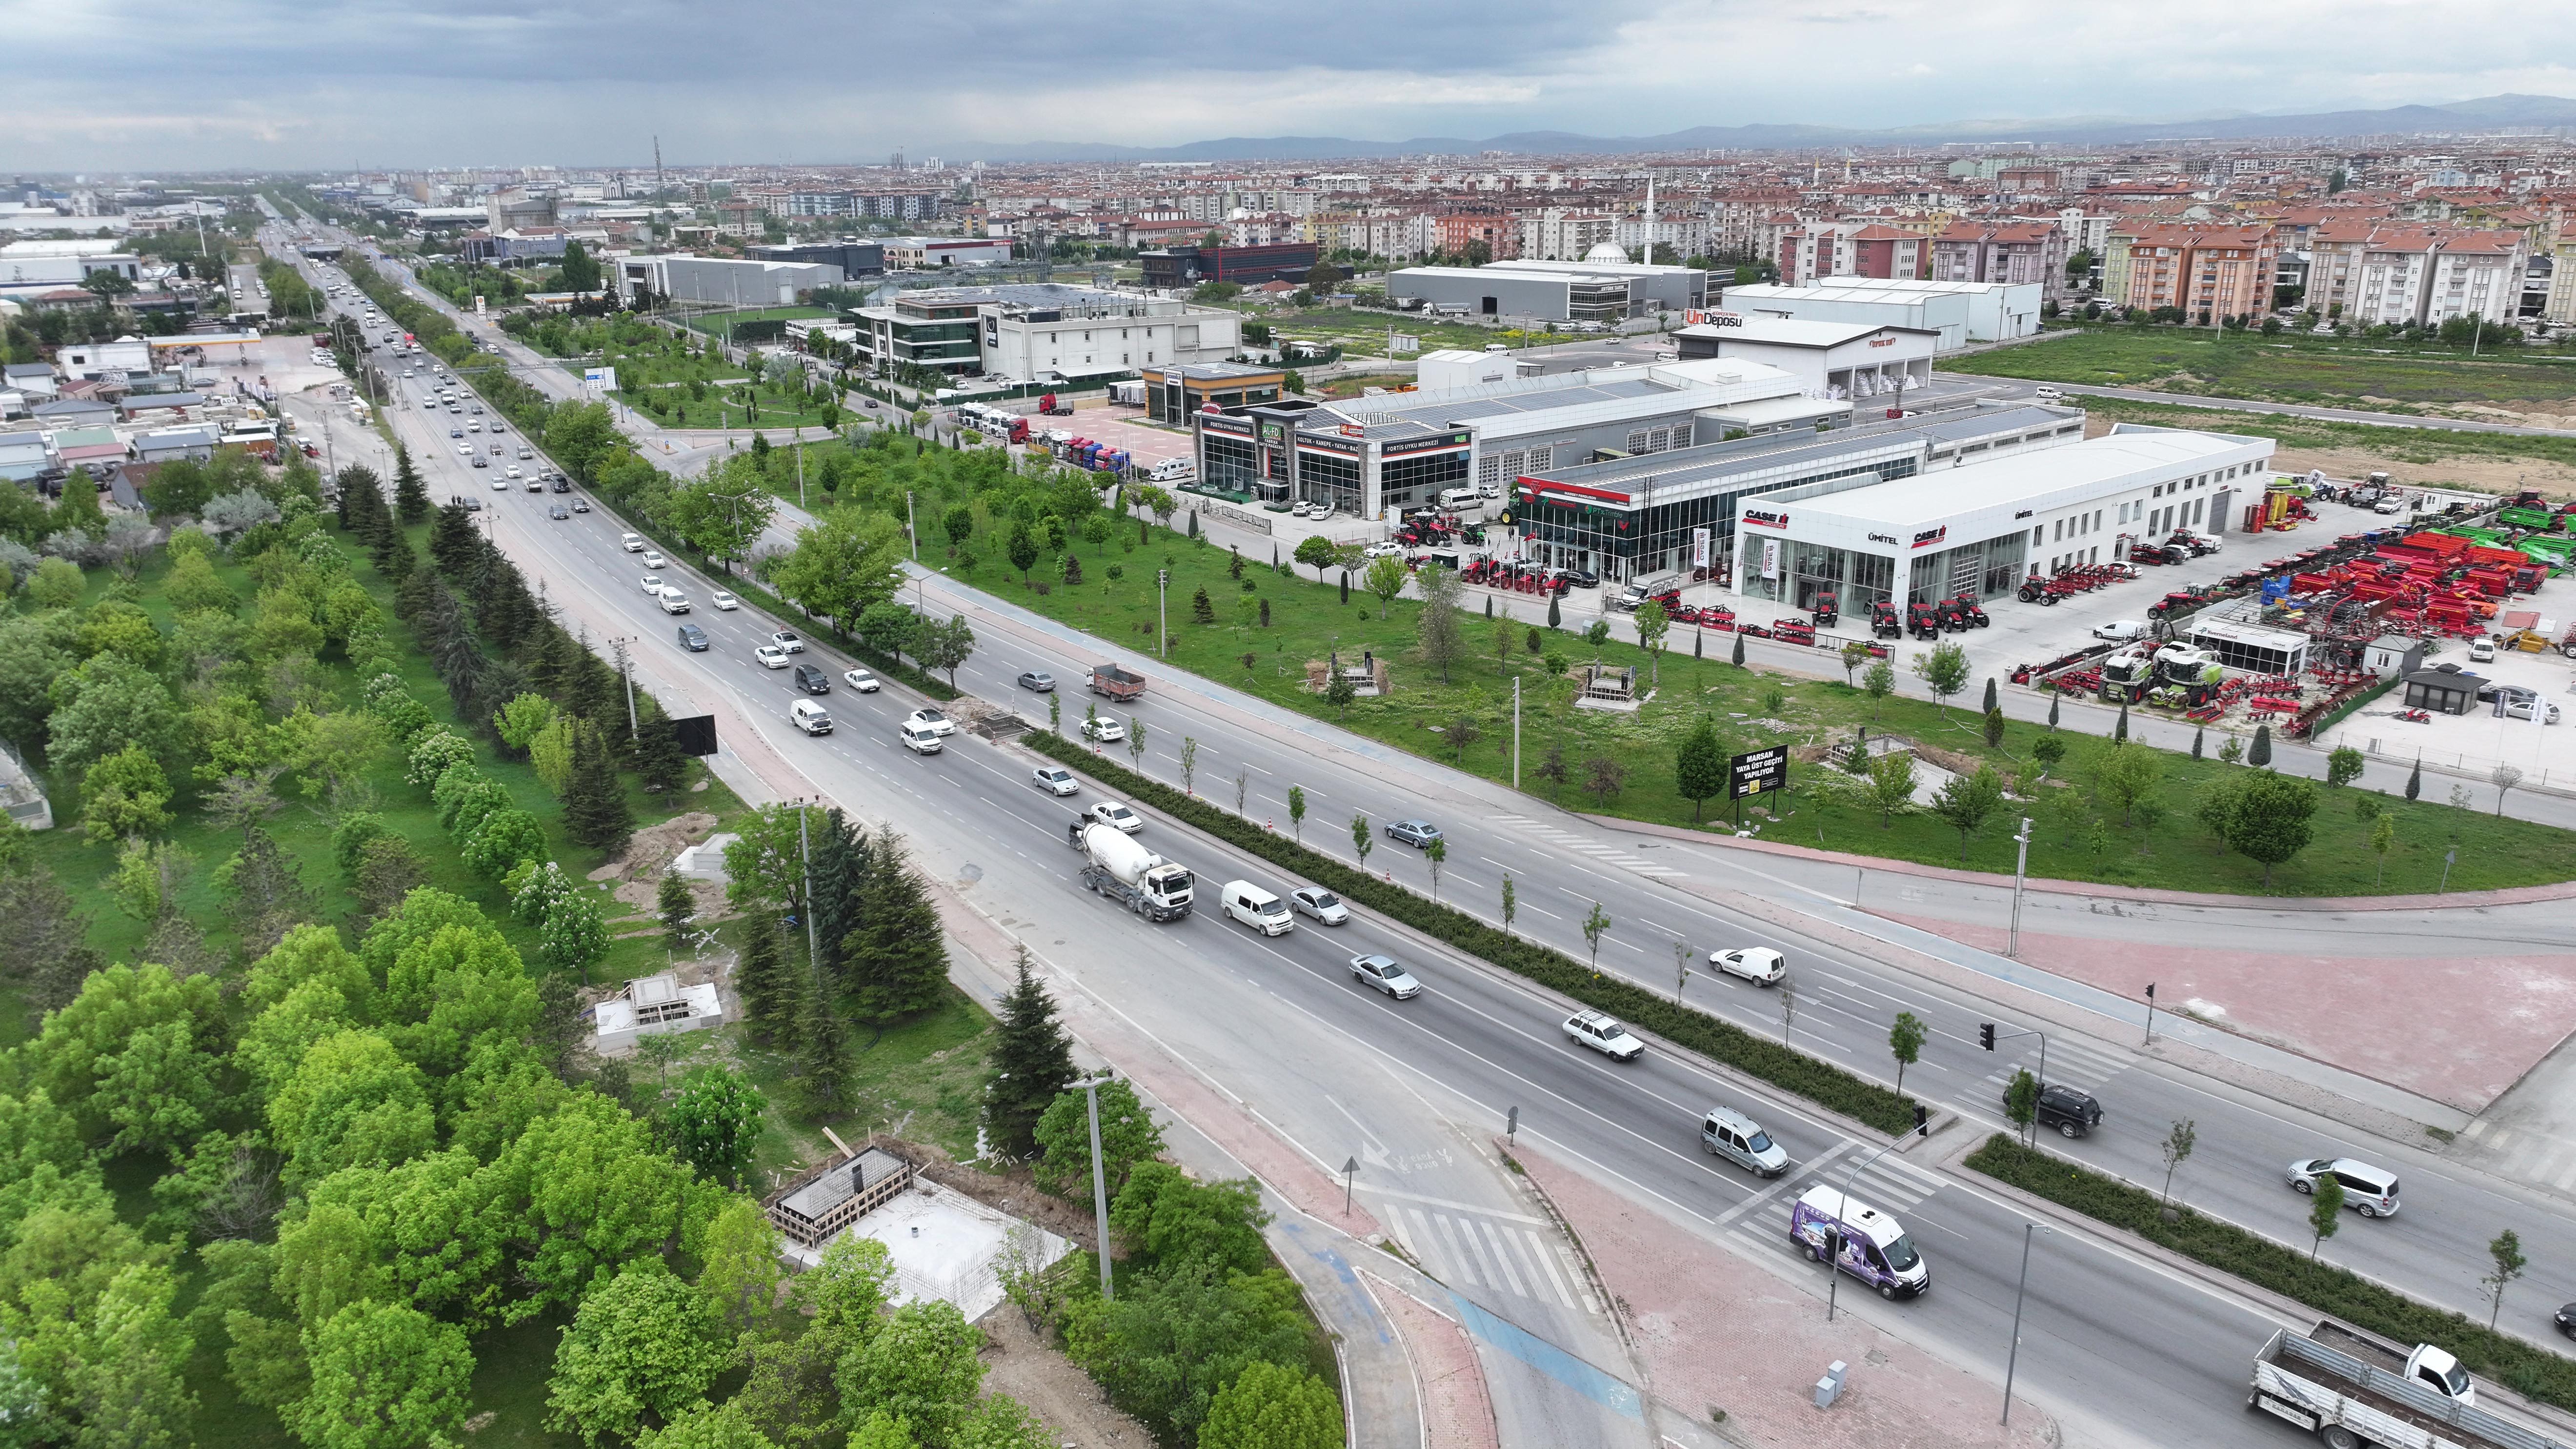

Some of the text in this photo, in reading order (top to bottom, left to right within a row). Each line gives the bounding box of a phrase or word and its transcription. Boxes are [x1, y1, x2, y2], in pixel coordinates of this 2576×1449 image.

[1418, 439, 1438, 447] MERKEZİ
[1605, 509, 1623, 519] Trimble
[1746, 509, 1777, 522] CASE
[2015, 510, 2033, 520] ÜMİTEL
[1868, 532, 1898, 545] ÜMİTEL
[1914, 529, 1938, 543] CASE
[2207, 630, 2237, 640] Kverneland
[1747, 750, 1773, 763] MARSAN
[1736, 755, 1783, 773] YAYA ÜST GEÇİTİ
[1744, 766, 1774, 779] YAPILIYOR
[1410, 1151, 1434, 1162] yaya
